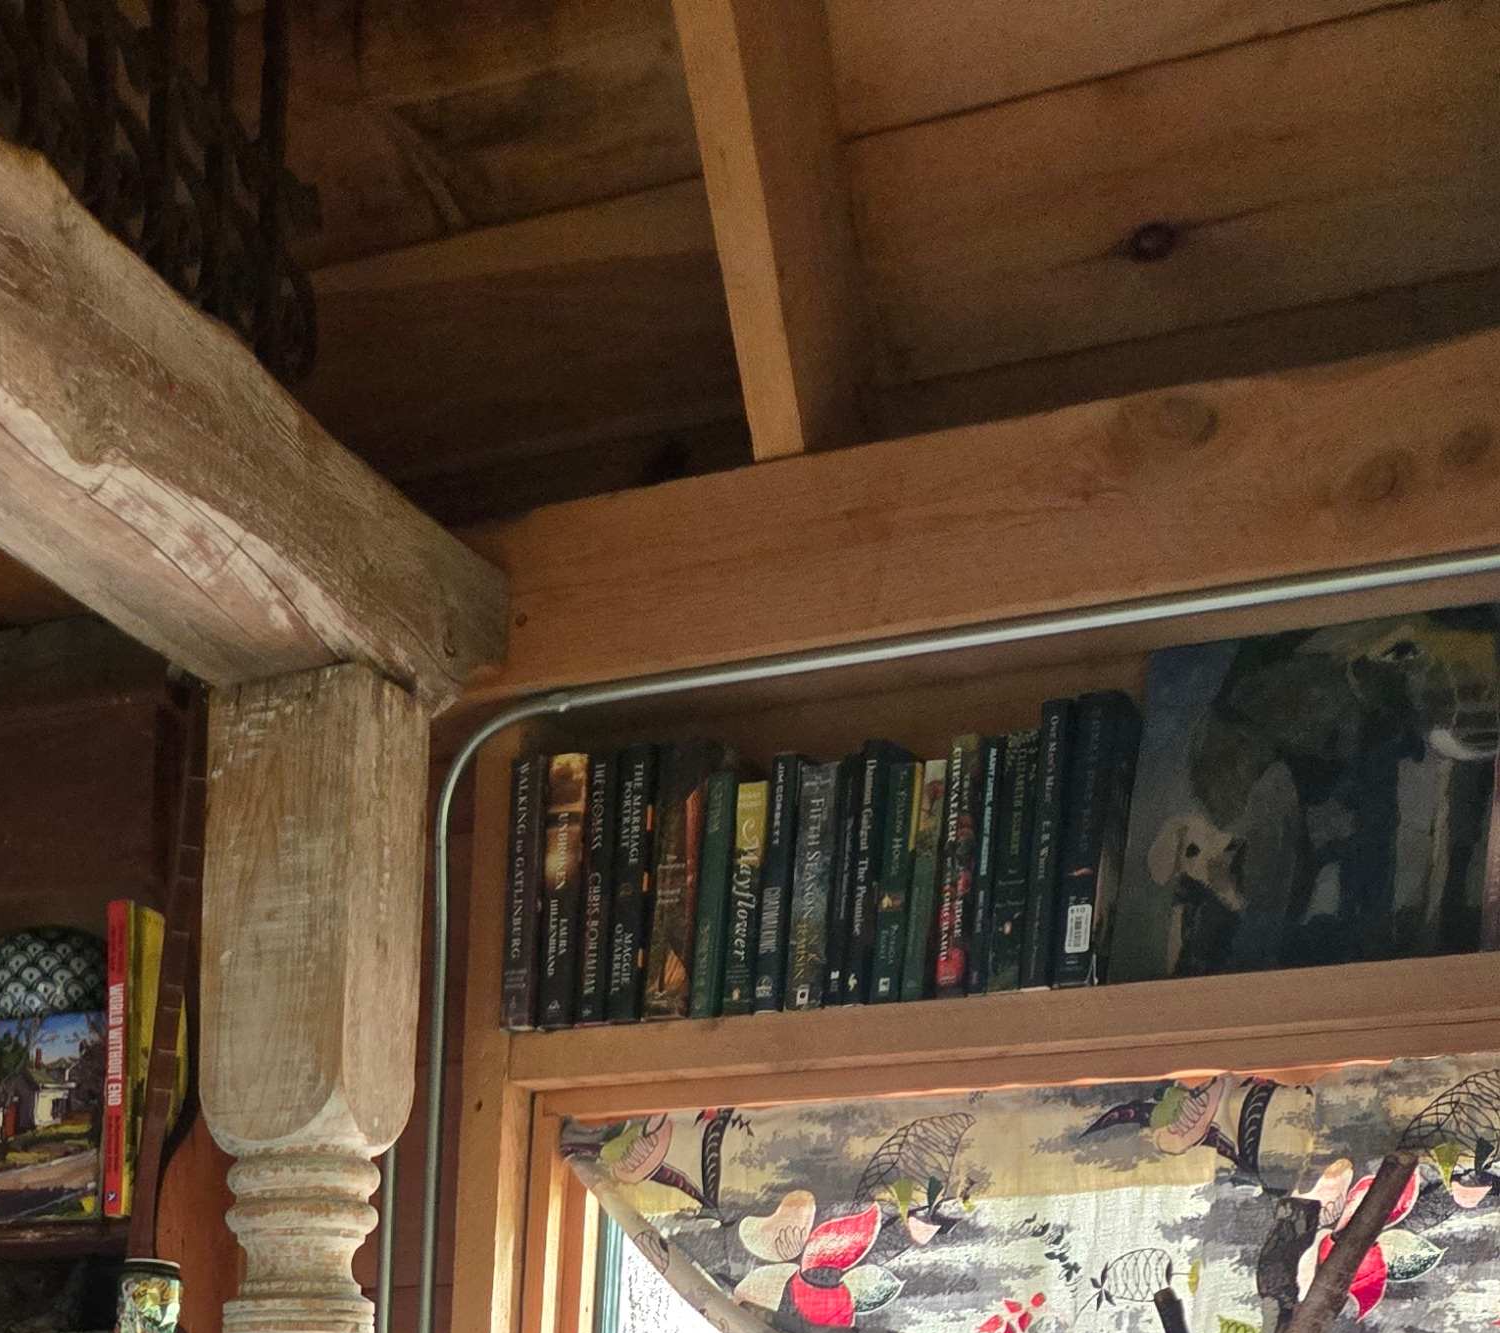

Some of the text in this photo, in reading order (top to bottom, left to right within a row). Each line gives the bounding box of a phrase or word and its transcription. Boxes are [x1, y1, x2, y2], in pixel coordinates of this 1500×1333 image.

[517, 761, 531, 835] WALKING
[592, 761, 606, 851] THE LIONESS
[621, 779, 634, 849] PORTRAIT
[629, 760, 645, 866] THE MARRIAGE
[773, 761, 787, 846] JIM CORBETT
[948, 747, 964, 843] CHEVALIER
[557, 812, 570, 891] UNBROKEN
[731, 818, 762, 962] Mayflower
[804, 797, 826, 922] FIFTH SEASON
[854, 759, 878, 937] Damon Galgut The Promise
[511, 857, 526, 960] GATLINBURG
[548, 898, 559, 977] HILLENBRAND
[559, 917, 570, 956] LAURA
[584, 871, 602, 996] CHRIS BOHJALIAN
[953, 898, 965, 938] EDGE
[622, 930, 634, 986] MAGGIE
[106, 981, 125, 1107] WORLD WITHOUT END
